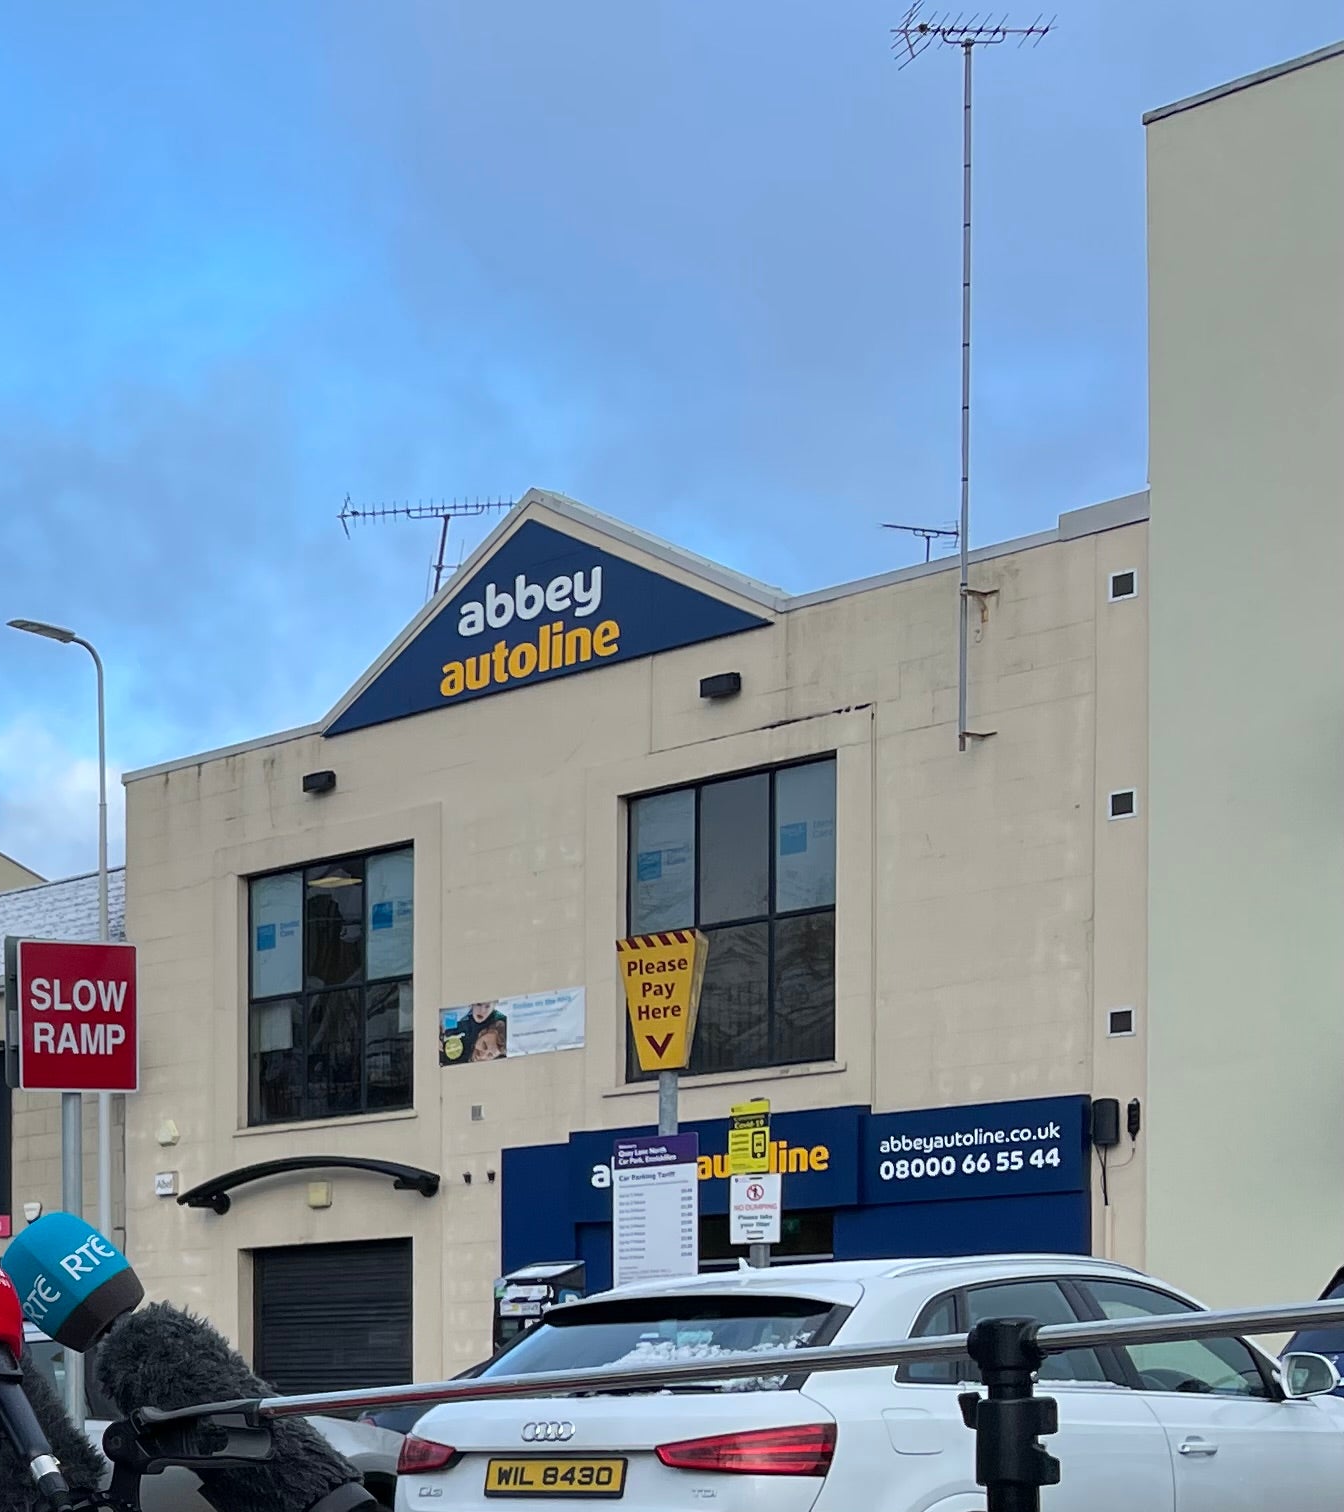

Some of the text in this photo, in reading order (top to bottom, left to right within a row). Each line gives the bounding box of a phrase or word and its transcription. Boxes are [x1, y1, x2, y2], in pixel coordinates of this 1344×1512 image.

[458, 565, 602, 637] abbey
[440, 619, 620, 697] autoline
[627, 957, 688, 976] Please
[30, 977, 127, 1012] SLOW
[641, 982, 675, 999] Pay
[637, 1004, 681, 1021] Here
[34, 1022, 126, 1055] RAMP
[879, 1121, 1061, 1153] abbeyautoline.co.uk
[619, 1174, 630, 1182] Car
[632, 1172, 656, 1181] Parking
[697, 1140, 830, 1181] auline
[879, 1147, 1061, 1180] 08000 66 55 44
[60, 1234, 115, 1281] RTÉ
[497, 1466, 613, 1486] WIL 8430
